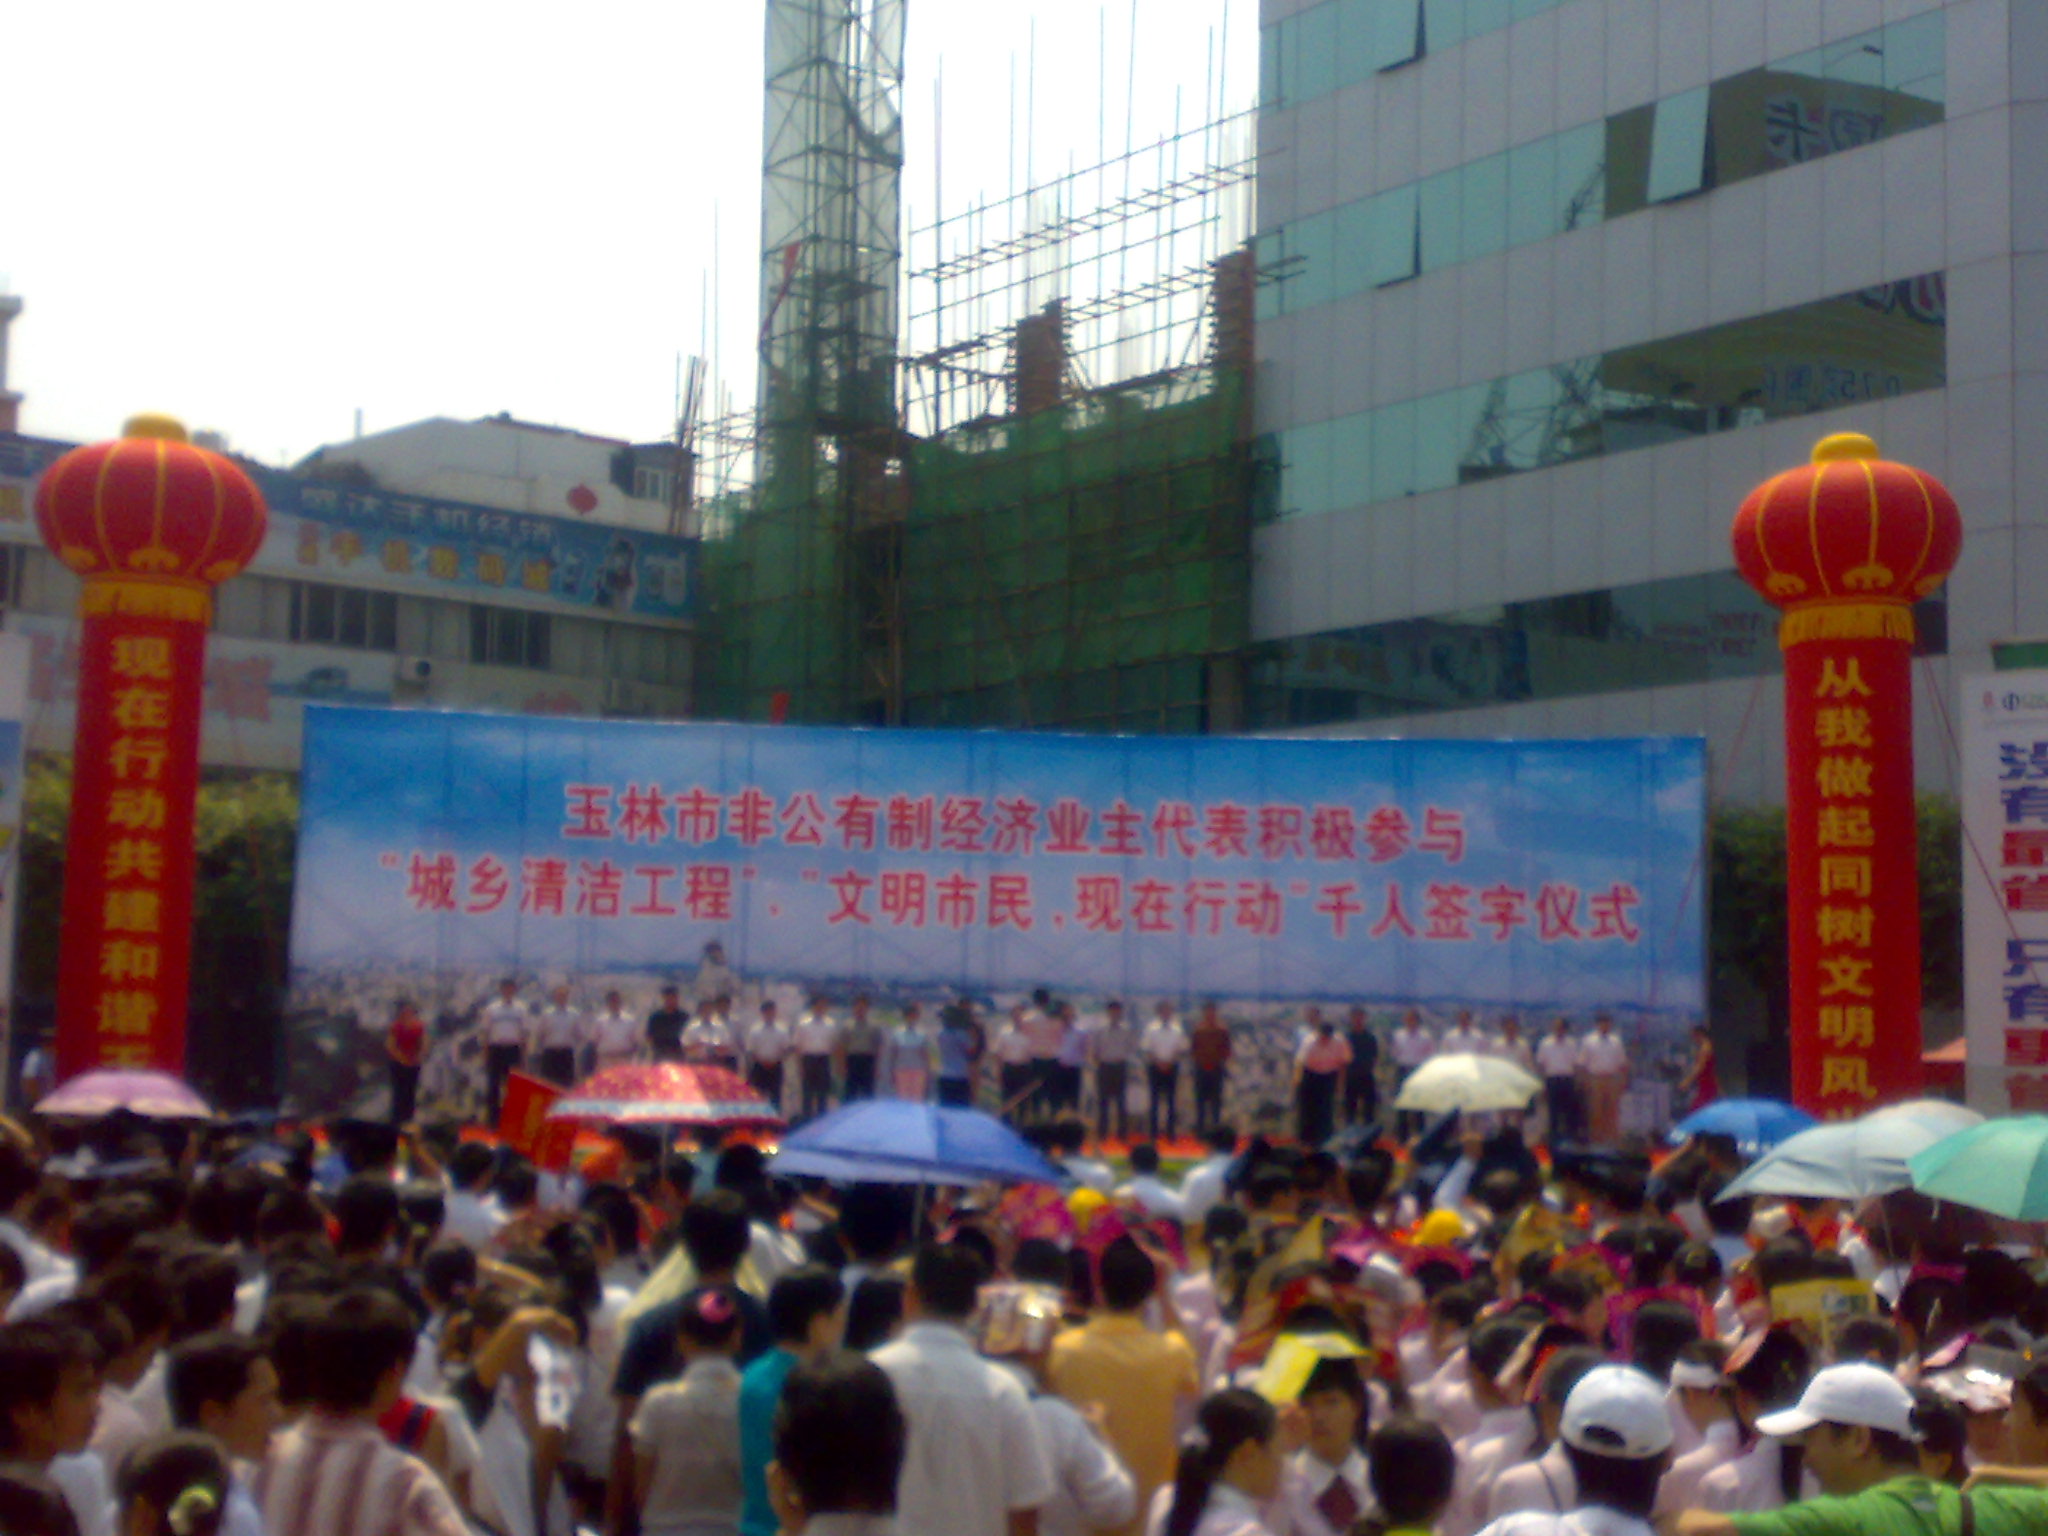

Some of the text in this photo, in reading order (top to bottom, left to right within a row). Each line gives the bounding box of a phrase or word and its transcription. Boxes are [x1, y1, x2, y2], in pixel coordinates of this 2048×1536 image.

[562, 783, 1467, 863] 玉林市非公有制经济业主代表积极参与
[1816, 657, 1877, 1117] 从我做起同树文明风
